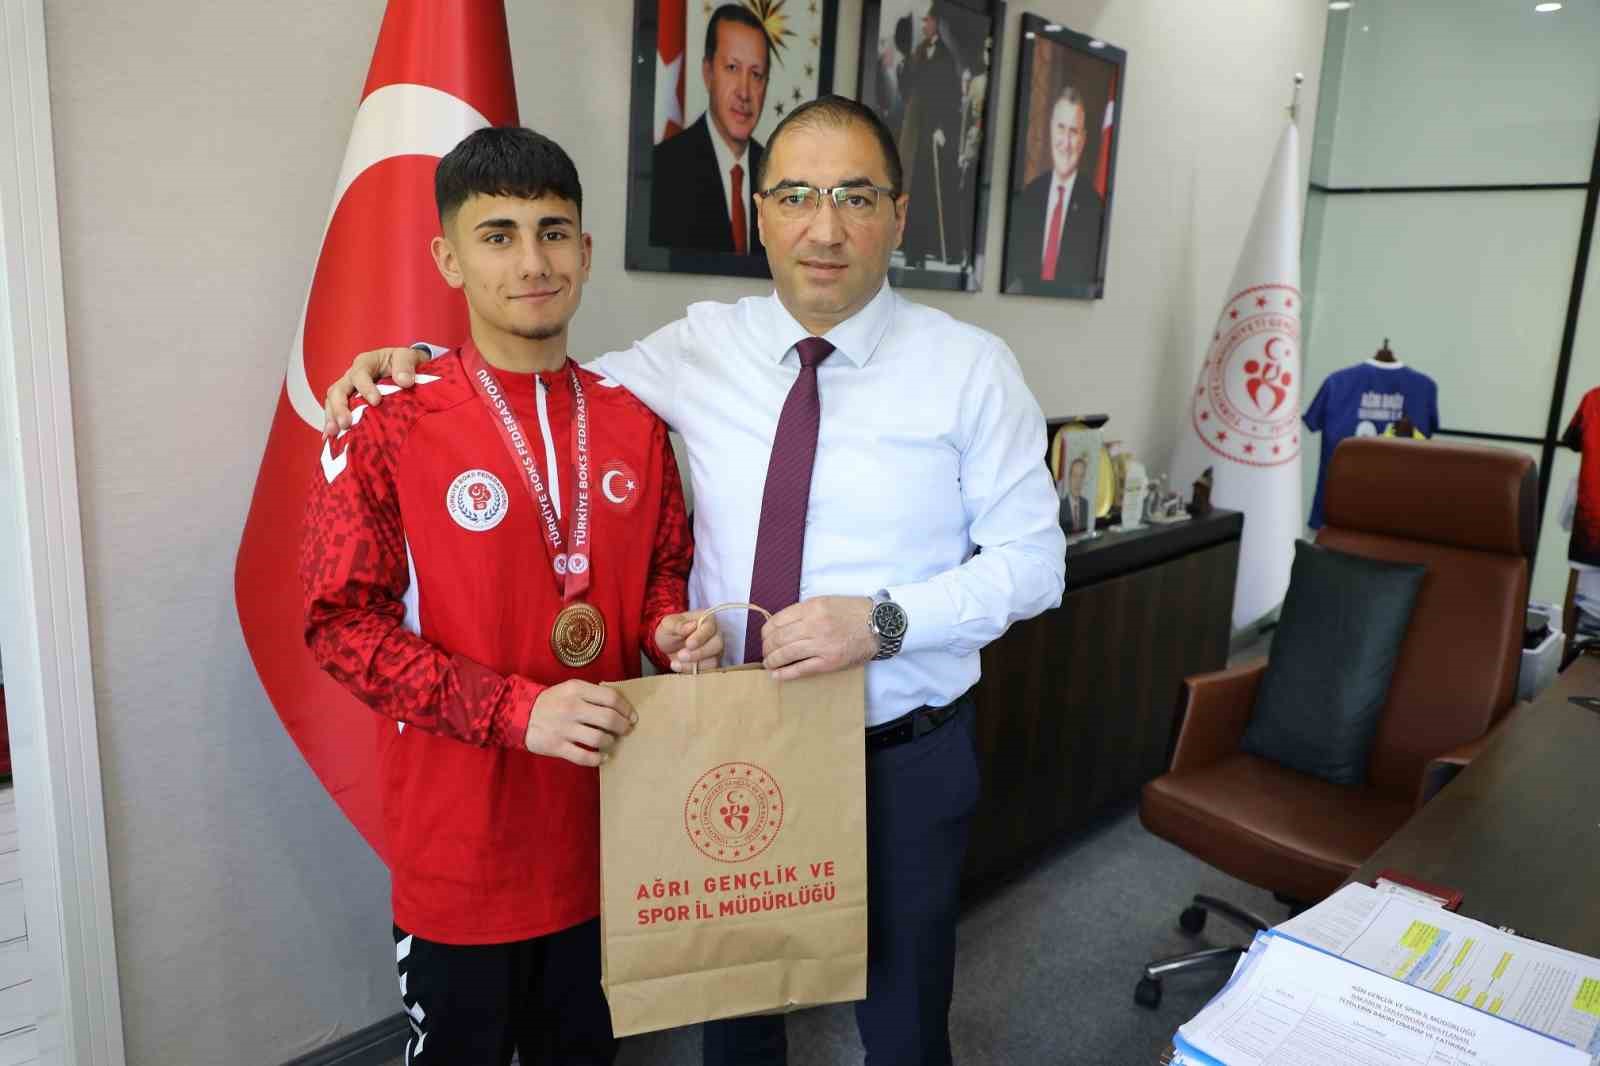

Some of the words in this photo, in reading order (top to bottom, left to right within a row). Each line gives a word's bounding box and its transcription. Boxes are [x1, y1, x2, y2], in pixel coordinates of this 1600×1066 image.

[476, 369, 528, 456] FEDERASYONU
[522, 456, 544, 492] BOKS
[578, 455, 589, 489] BOKS
[538, 493, 562, 548] TÜRKİYE
[574, 491, 588, 547] TÜRKİYE
[636, 878, 690, 900] AĞRI
[703, 864, 798, 893] GENÇLİK
[809, 861, 836, 879] VE
[637, 905, 690, 926] SPOR
[696, 900, 714, 920] İL
[718, 881, 836, 917] MÜDÜRLÜĞÜ
